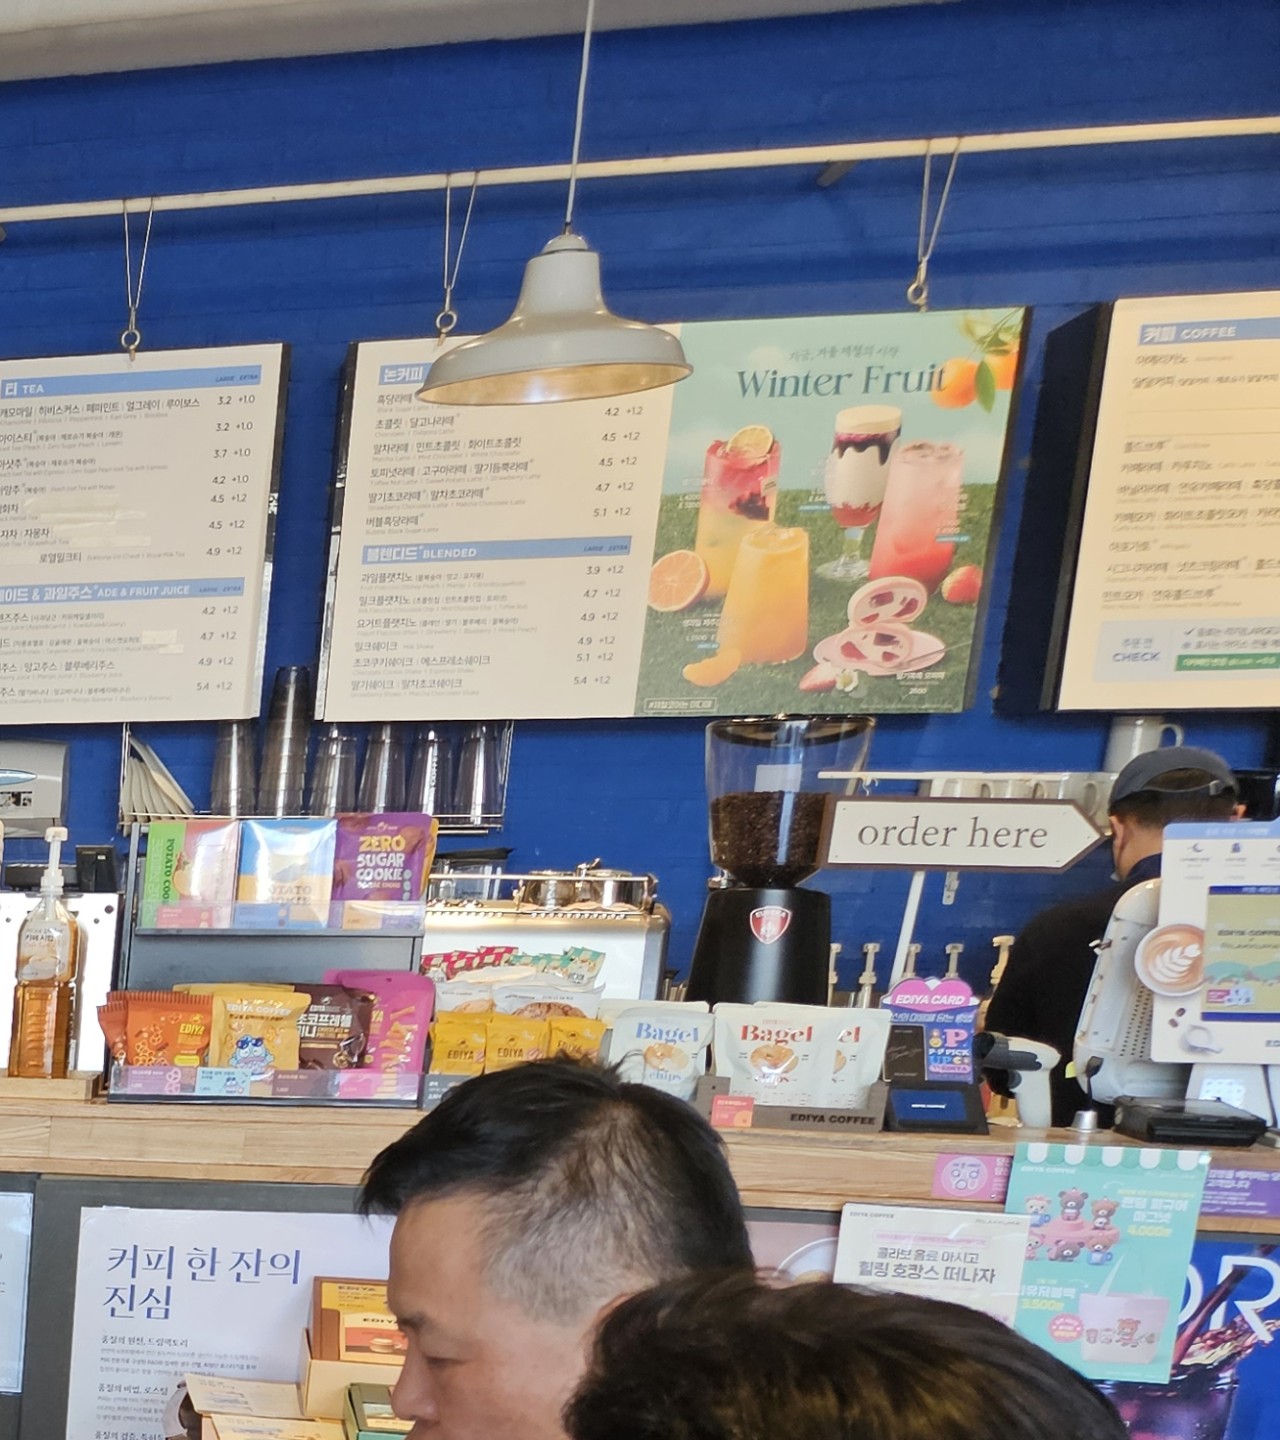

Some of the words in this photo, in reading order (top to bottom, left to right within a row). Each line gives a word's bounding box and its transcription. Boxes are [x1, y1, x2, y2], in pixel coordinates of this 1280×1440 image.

[1144, 327, 1176, 343] 커피
[1181, 327, 1236, 340] COFFEE
[384, 368, 423, 382] 논커피
[737, 369, 853, 399] Winter
[861, 363, 950, 394] Fruit
[22, 384, 44, 394] TEA
[217, 396, 232, 405] 3.2
[377, 394, 413, 405] 흑당라떼
[0, 406, 32, 417] 캐모마일
[39, 404, 80, 415] 히비스커스
[126, 400, 160, 412] 얼그레이
[166, 398, 200, 409] 루이보스
[376, 419, 402, 429] 초콜릿
[410, 416, 454, 428] 달고나라떼
[601, 433, 616, 441] 4.5
[373, 443, 408, 455] 말차라떼
[416, 440, 461, 452] 민트초콜릿
[468, 437, 522, 449] 화이트초콜릿
[213, 449, 227, 458] 3.7
[370, 467, 415, 478] 토피넛라떼
[422, 464, 467, 475] 고구마라떼
[595, 483, 610, 492] 4.7
[210, 495, 225, 503] 4.5
[368, 491, 421, 503] 딸기초코라떼
[430, 489, 483, 501] 말차초코라떼
[366, 515, 418, 527] 버블흑당라떼
[24, 528, 49, 539] 자몽차
[206, 547, 220, 555] 4.9
[367, 547, 417, 561] 블렌디드
[423, 549, 477, 559] BLENDED
[40, 552, 81, 563] 로열밀크티
[586, 566, 600, 574] 3.9
[361, 573, 412, 583] 과일플랫치노
[32, 588, 40, 600] &
[44, 586, 92, 600] 과일주스
[97, 587, 118, 597] ADE
[130, 587, 158, 596] FRUIT
[161, 585, 190, 595] JUICE
[359, 596, 410, 606] 밀크플랫치노
[580, 613, 595, 621] 4.9
[357, 618, 416, 629] 요거트플랫치노
[201, 632, 214, 640] 4.7
[355, 641, 397, 652] 밀크쉐이크
[353, 657, 413, 668] 초코쿠키쉐이크
[421, 655, 490, 666] 에스프레소쉐이크
[576, 653, 590, 662] 5.1
[1112, 652, 1160, 662] CHECK
[25, 662, 57, 672] 망고주스
[65, 660, 115, 671] 블루베리주스
[197, 682, 210, 691] 5.4
[351, 680, 394, 691] 딸기쉐이크
[402, 679, 462, 690] 말차초코쉐이크
[858, 816, 957, 847] order
[967, 817, 1047, 849] here
[358, 835, 406, 852] ZERO
[164, 839, 175, 877] POTATO
[356, 853, 405, 868] SUGAR
[356, 868, 403, 881] COOKIE
[895, 994, 928, 1004] EDIYA
[931, 995, 965, 1005] CARD
[227, 1002, 253, 1013] EDIYA
[256, 1006, 292, 1015] COFFEE
[179, 1023, 204, 1035] EDIYA
[636, 1022, 699, 1044] Bagel
[741, 1025, 813, 1045] Bagel
[448, 1049, 474, 1060] EDIYA
[498, 1048, 523, 1058] EDIYA
[649, 1070, 682, 1082] chips
[791, 1113, 825, 1123] EDIYA
[829, 1115, 876, 1125] COFFEE
[1150, 1198, 1188, 1211] 피규어
[877, 1247, 912, 1260] 콜라보
[913, 1248, 939, 1262] 음료
[941, 1252, 979, 1264] 마시고
[107, 1245, 174, 1280] 커피
[187, 1247, 220, 1282] 한
[229, 1248, 300, 1285] 잔의
[859, 1261, 889, 1278] 힐링
[891, 1263, 939, 1281] 호캉스
[943, 1267, 996, 1284] 떠나자
[103, 1284, 171, 1319] 진심
[102, 1335, 125, 1345] 품질의
[98, 1383, 121, 1393] 품질의
[144, 1387, 168, 1395] 로스팅
[95, 1431, 118, 1440] 품질의
